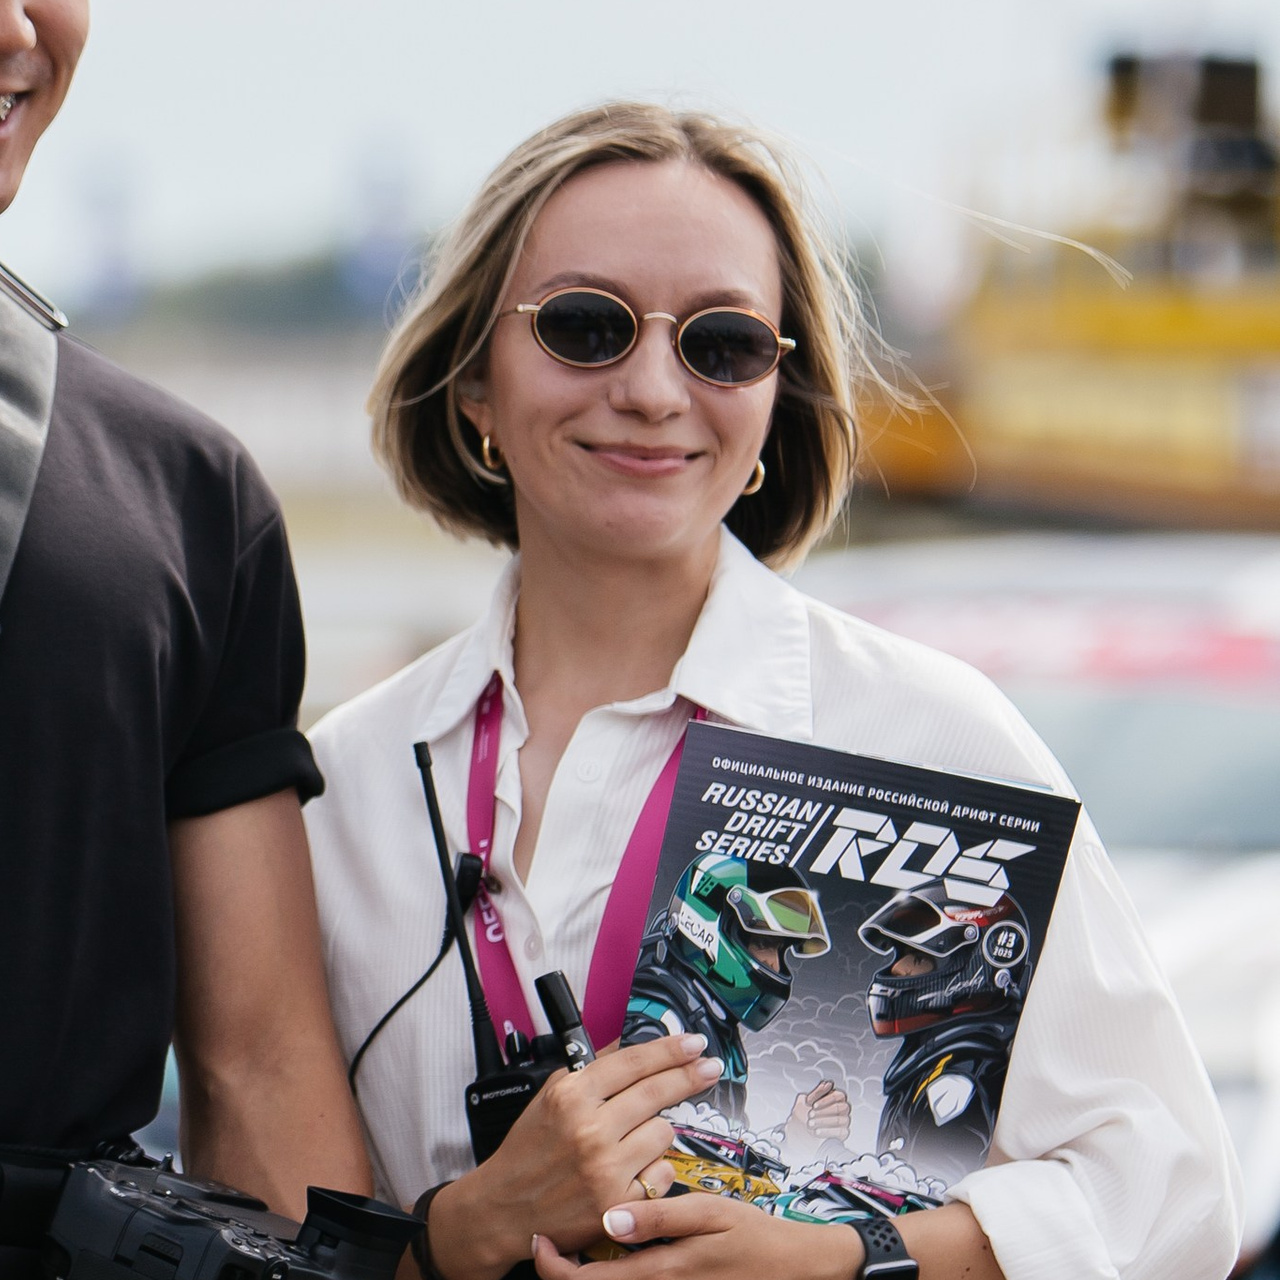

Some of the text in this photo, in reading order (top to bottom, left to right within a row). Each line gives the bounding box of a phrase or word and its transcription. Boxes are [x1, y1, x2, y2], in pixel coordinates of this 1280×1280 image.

[701, 781, 822, 823] RUSSIAN
[712, 756, 1041, 833] ОФИЦИАЛЬНОЕ ИЗДАНИЕ РОССИЙСКОЙ ДРИФТ СЕРИИ
[723, 810, 807, 843] DRIFT
[695, 830, 790, 865] SERIES
[809, 806, 1037, 908] RDS
[997, 930, 1018, 948] #3
[482, 1083, 531, 1100] MOTOROLA
